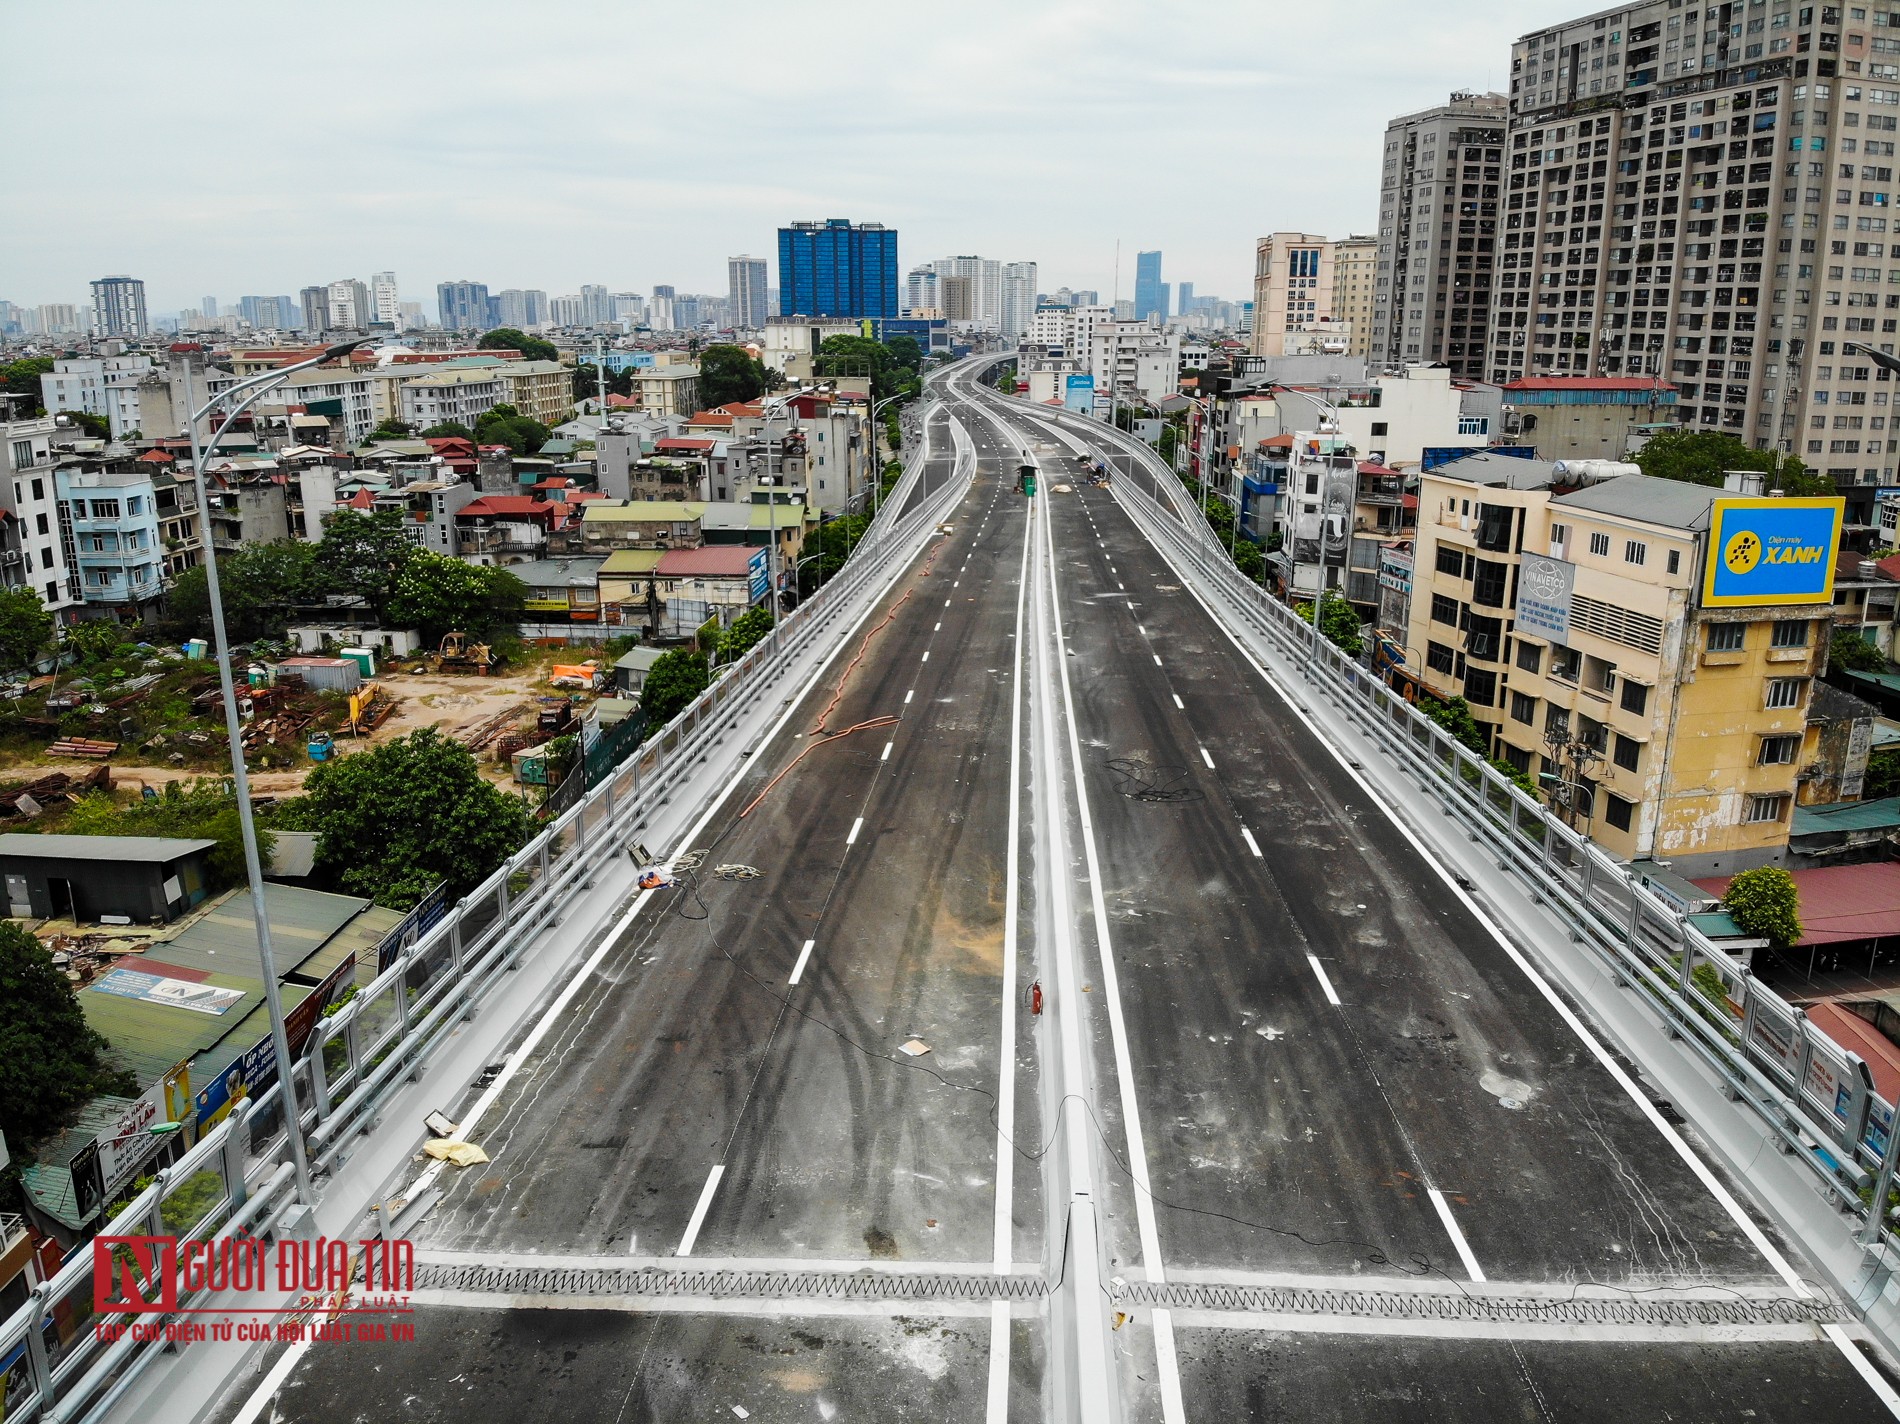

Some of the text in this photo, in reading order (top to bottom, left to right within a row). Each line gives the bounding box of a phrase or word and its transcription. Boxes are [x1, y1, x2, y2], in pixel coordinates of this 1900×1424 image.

[1762, 545, 1824, 565] XANH
[1525, 570, 1565, 589] VINAVETCO
[138, 1106, 156, 1127] LAN
